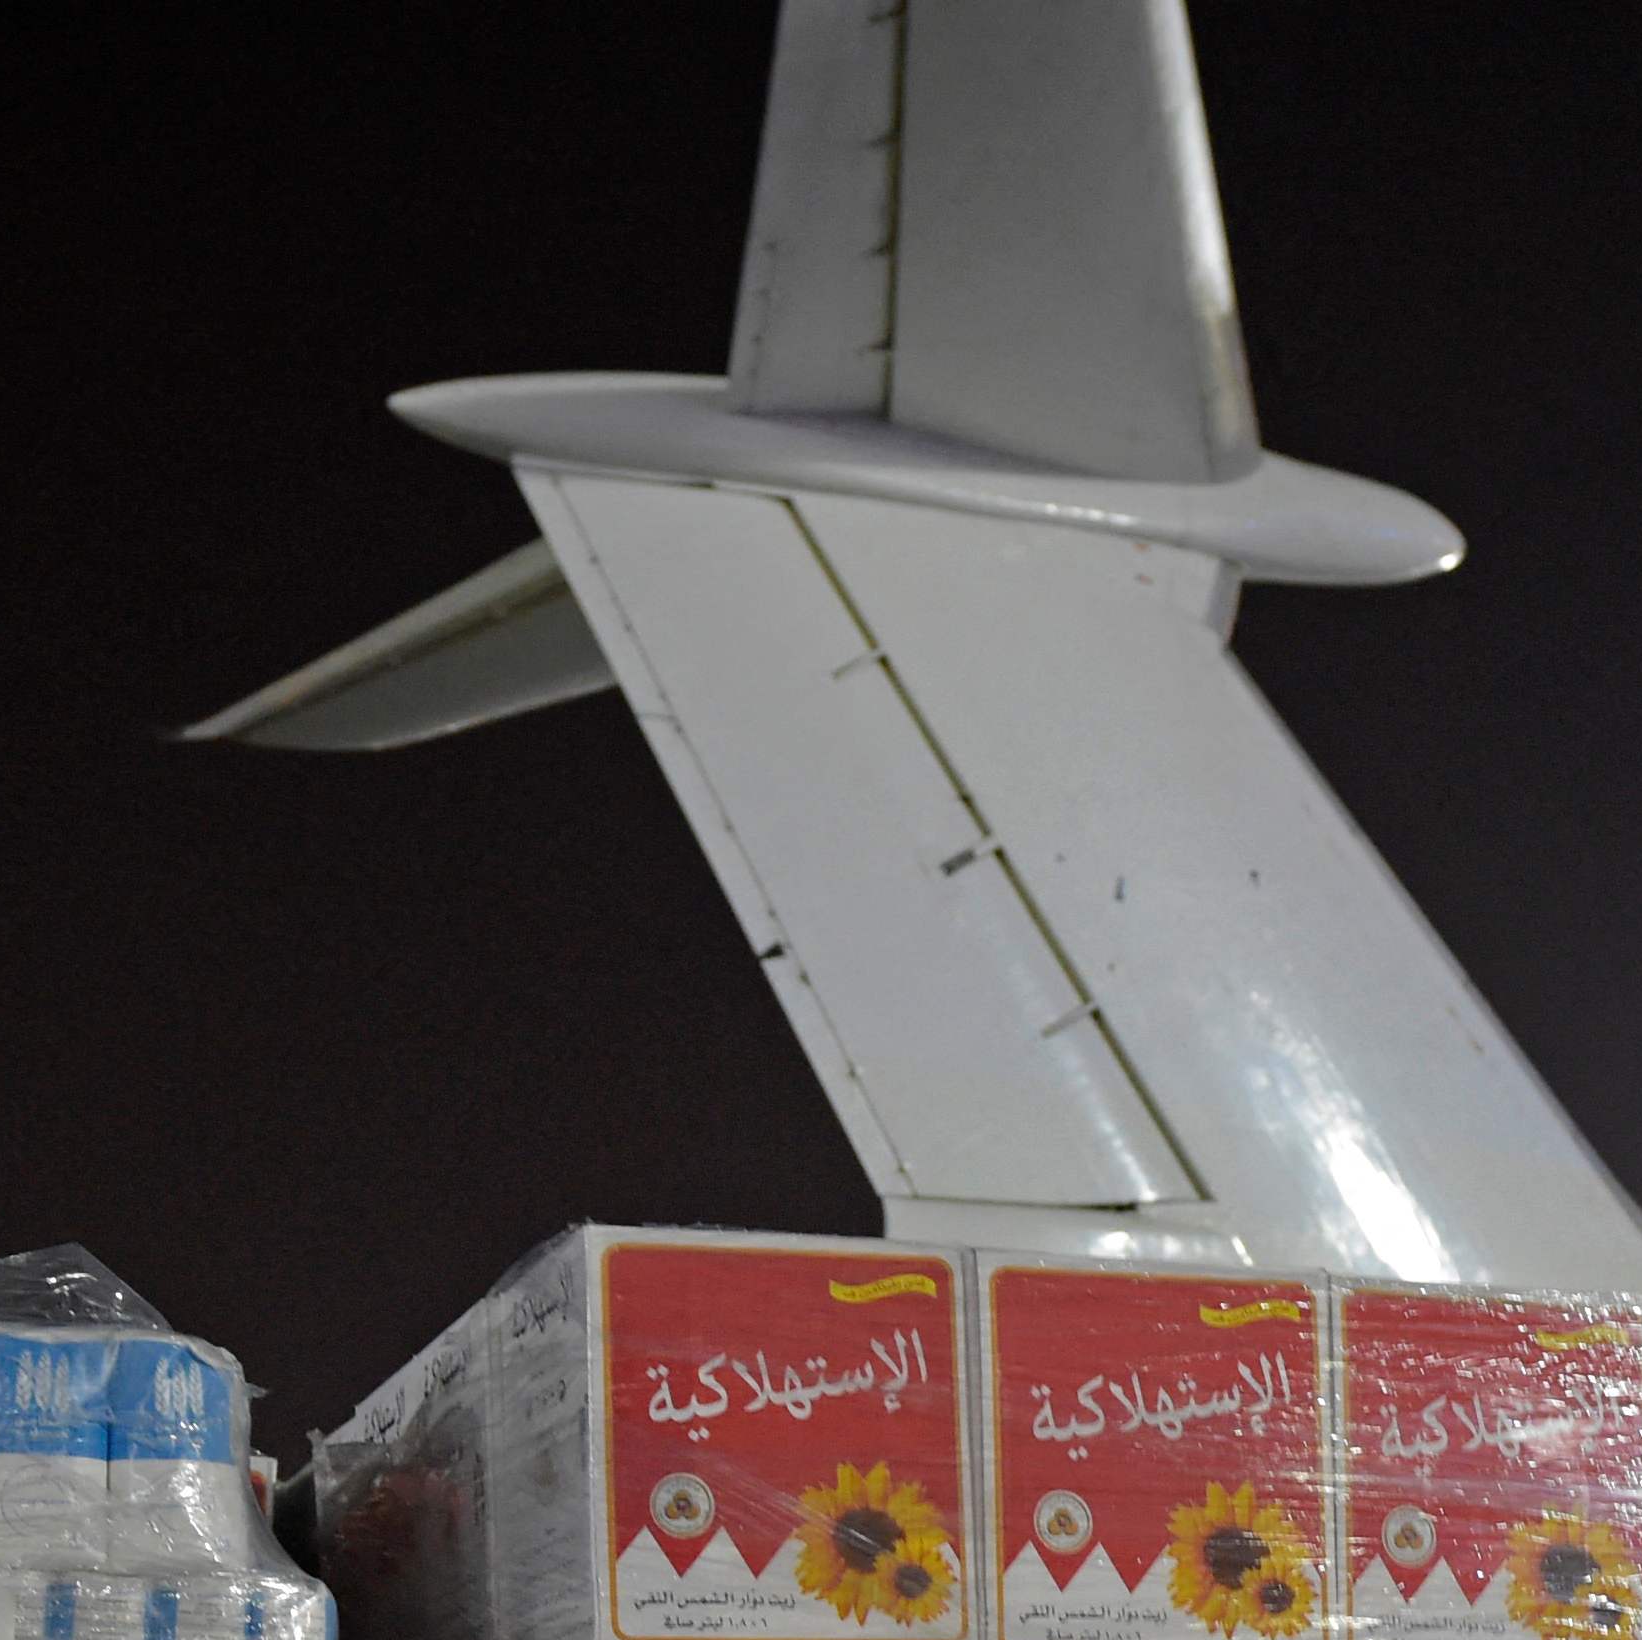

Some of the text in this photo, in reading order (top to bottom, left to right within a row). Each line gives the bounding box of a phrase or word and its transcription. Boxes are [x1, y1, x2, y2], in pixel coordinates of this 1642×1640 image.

[647, 1328, 927, 1442] الإستهلاكية
[1031, 1351, 1291, 1461] الإستهلاكية
[1379, 1382, 1623, 1478] الإستهلاكية
[633, 1591, 674, 1610] النقي
[678, 1591, 734, 1609] الشمس
[768, 1593, 796, 1609] زيت
